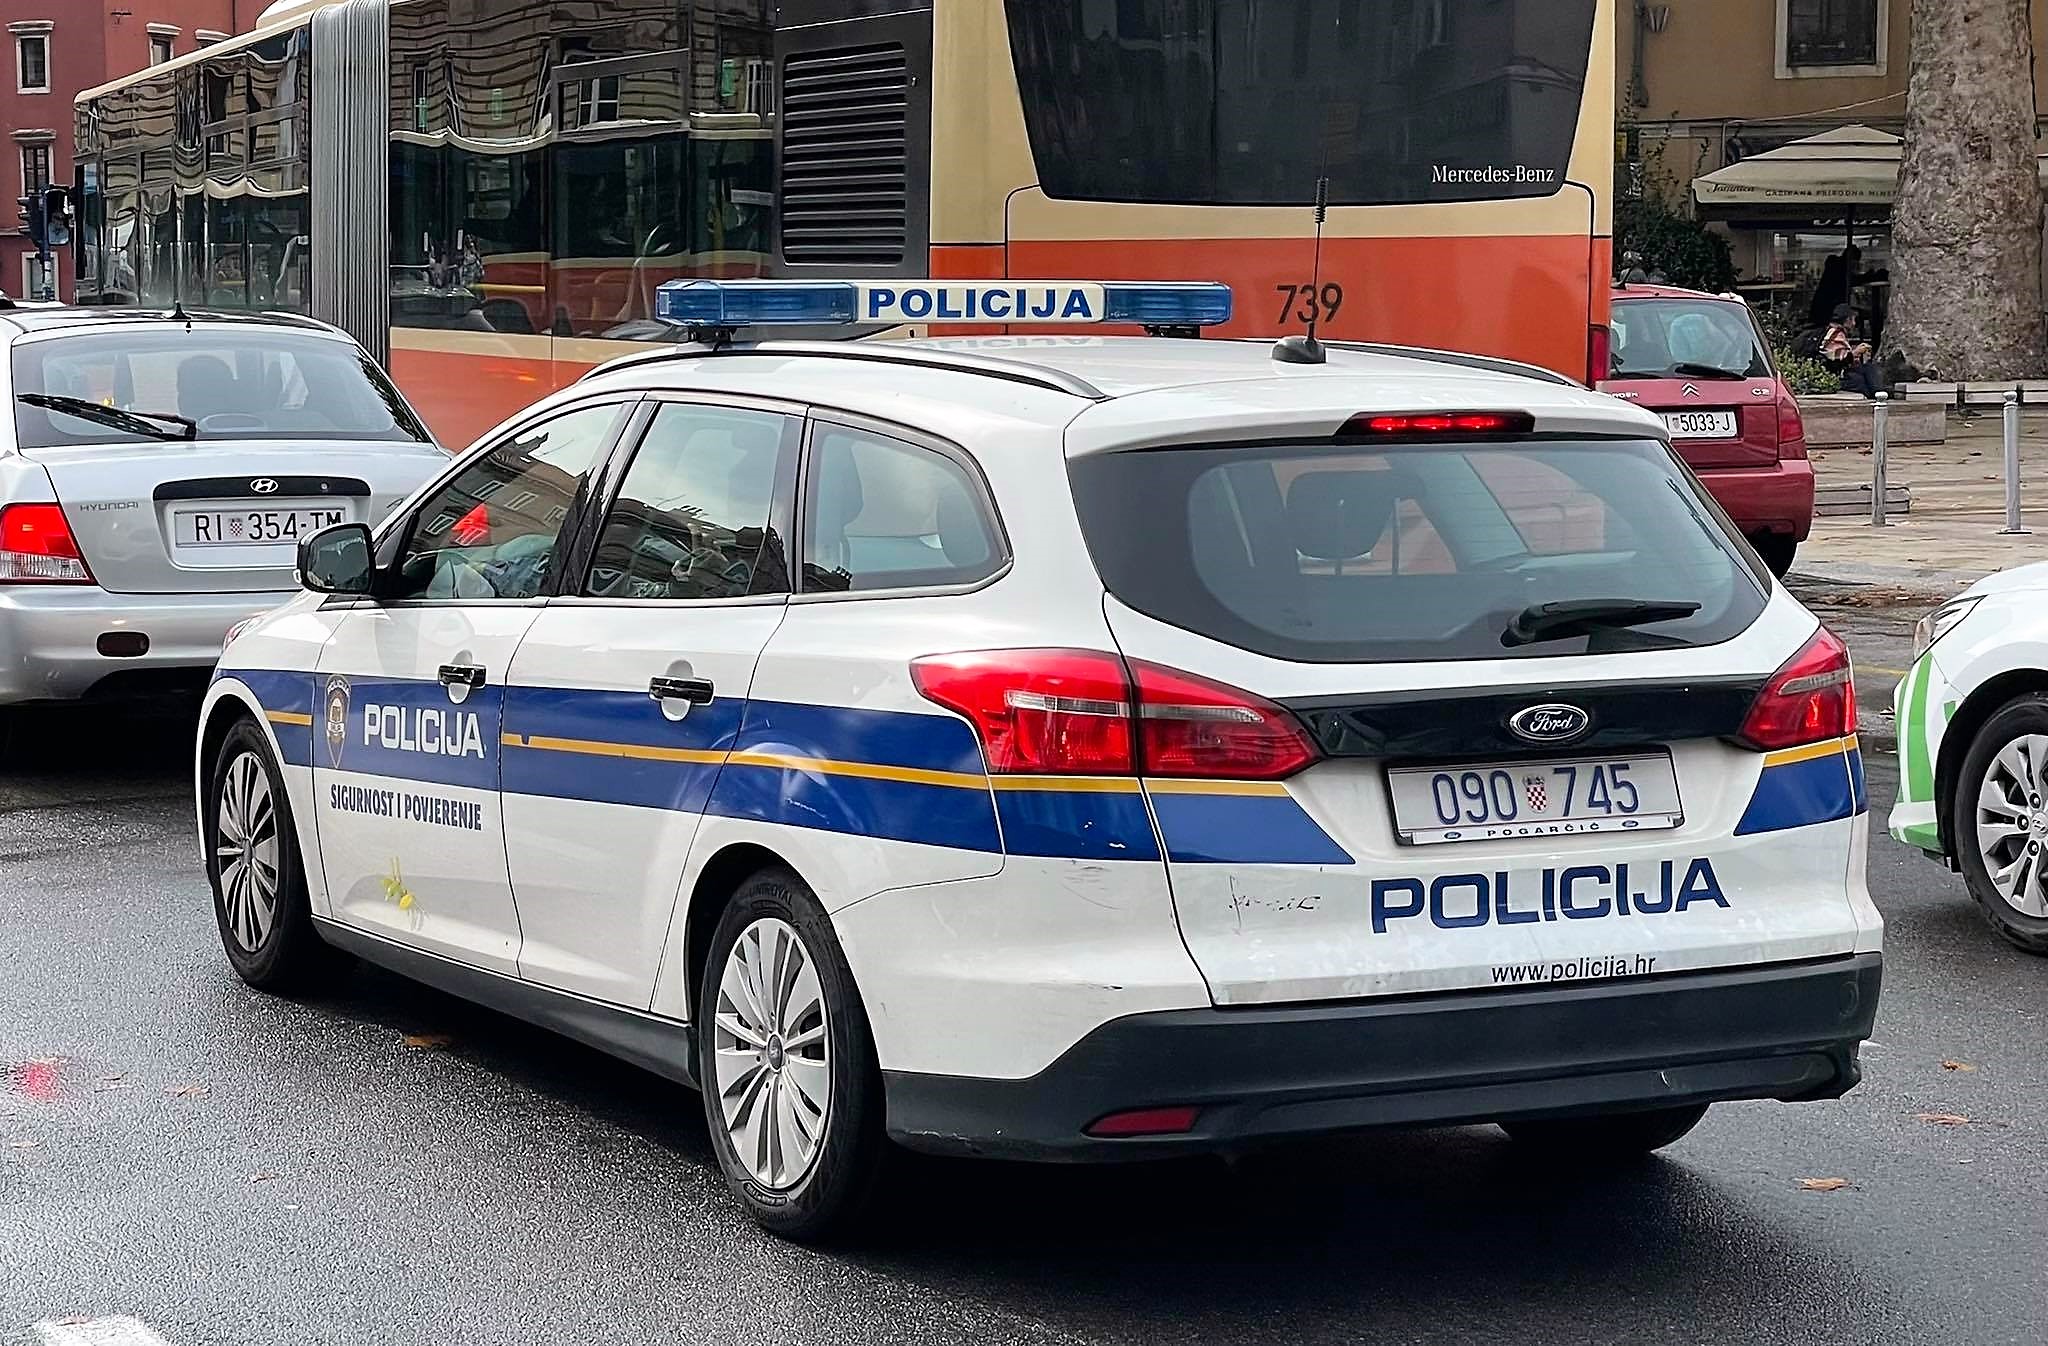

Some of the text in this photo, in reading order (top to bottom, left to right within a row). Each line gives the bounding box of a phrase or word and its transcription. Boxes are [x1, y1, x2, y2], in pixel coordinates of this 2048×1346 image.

[1431, 165, 1554, 183] Mercedes-Benz
[868, 288, 1093, 318] POLICIJA
[1277, 283, 1343, 324] 739
[1680, 413, 1730, 431] 5033-J
[80, 502, 139, 512] HYUNDAI
[194, 514, 222, 542] RI
[364, 703, 485, 760] POLICIJA
[1529, 710, 1574, 732] Ford
[330, 783, 482, 832] SIGURNOST I POVJERENJE
[1432, 763, 1640, 826] 090 745
[1487, 822, 1601, 838] POGARČIĆ
[1370, 857, 1732, 934] POLICIJA
[1491, 954, 1657, 983] www.policija.hr
